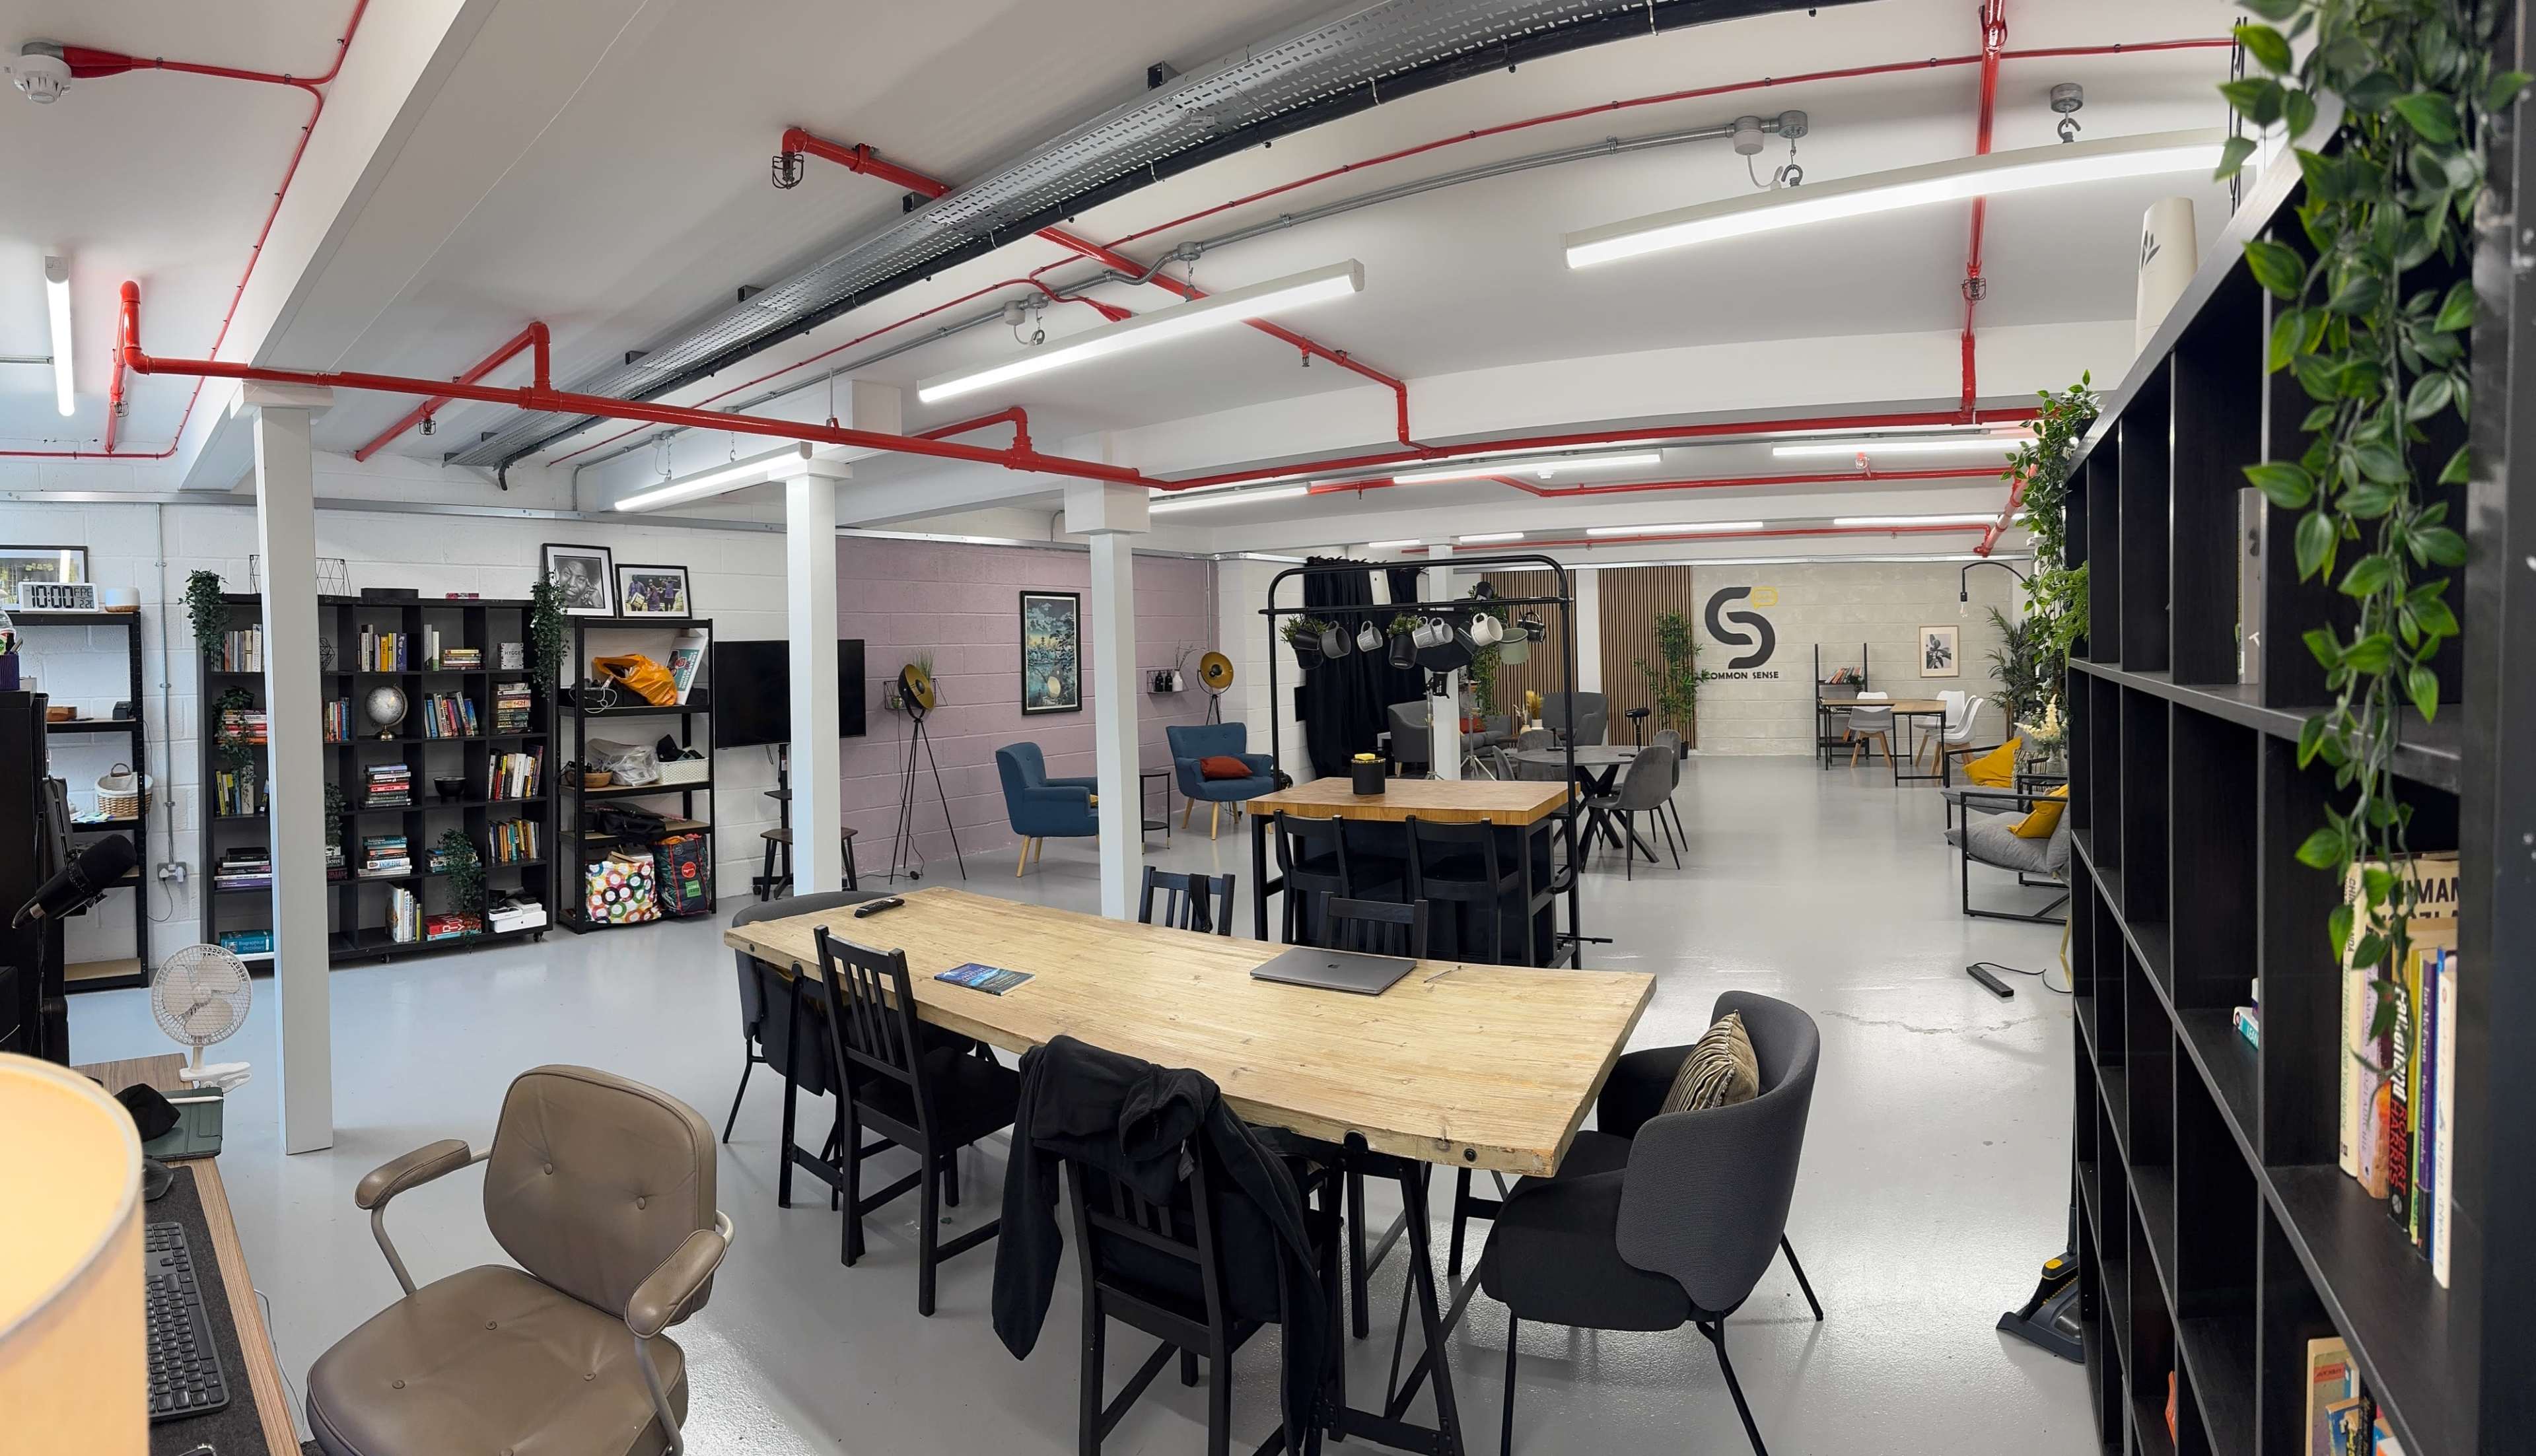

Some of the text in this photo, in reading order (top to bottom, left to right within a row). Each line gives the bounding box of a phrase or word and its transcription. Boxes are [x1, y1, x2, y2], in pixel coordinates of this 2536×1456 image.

[31, 585, 75, 608] 10:00
[2389, 1097, 2399, 1188] HARRIS
[2397, 1103, 2407, 1196] ROBERT
